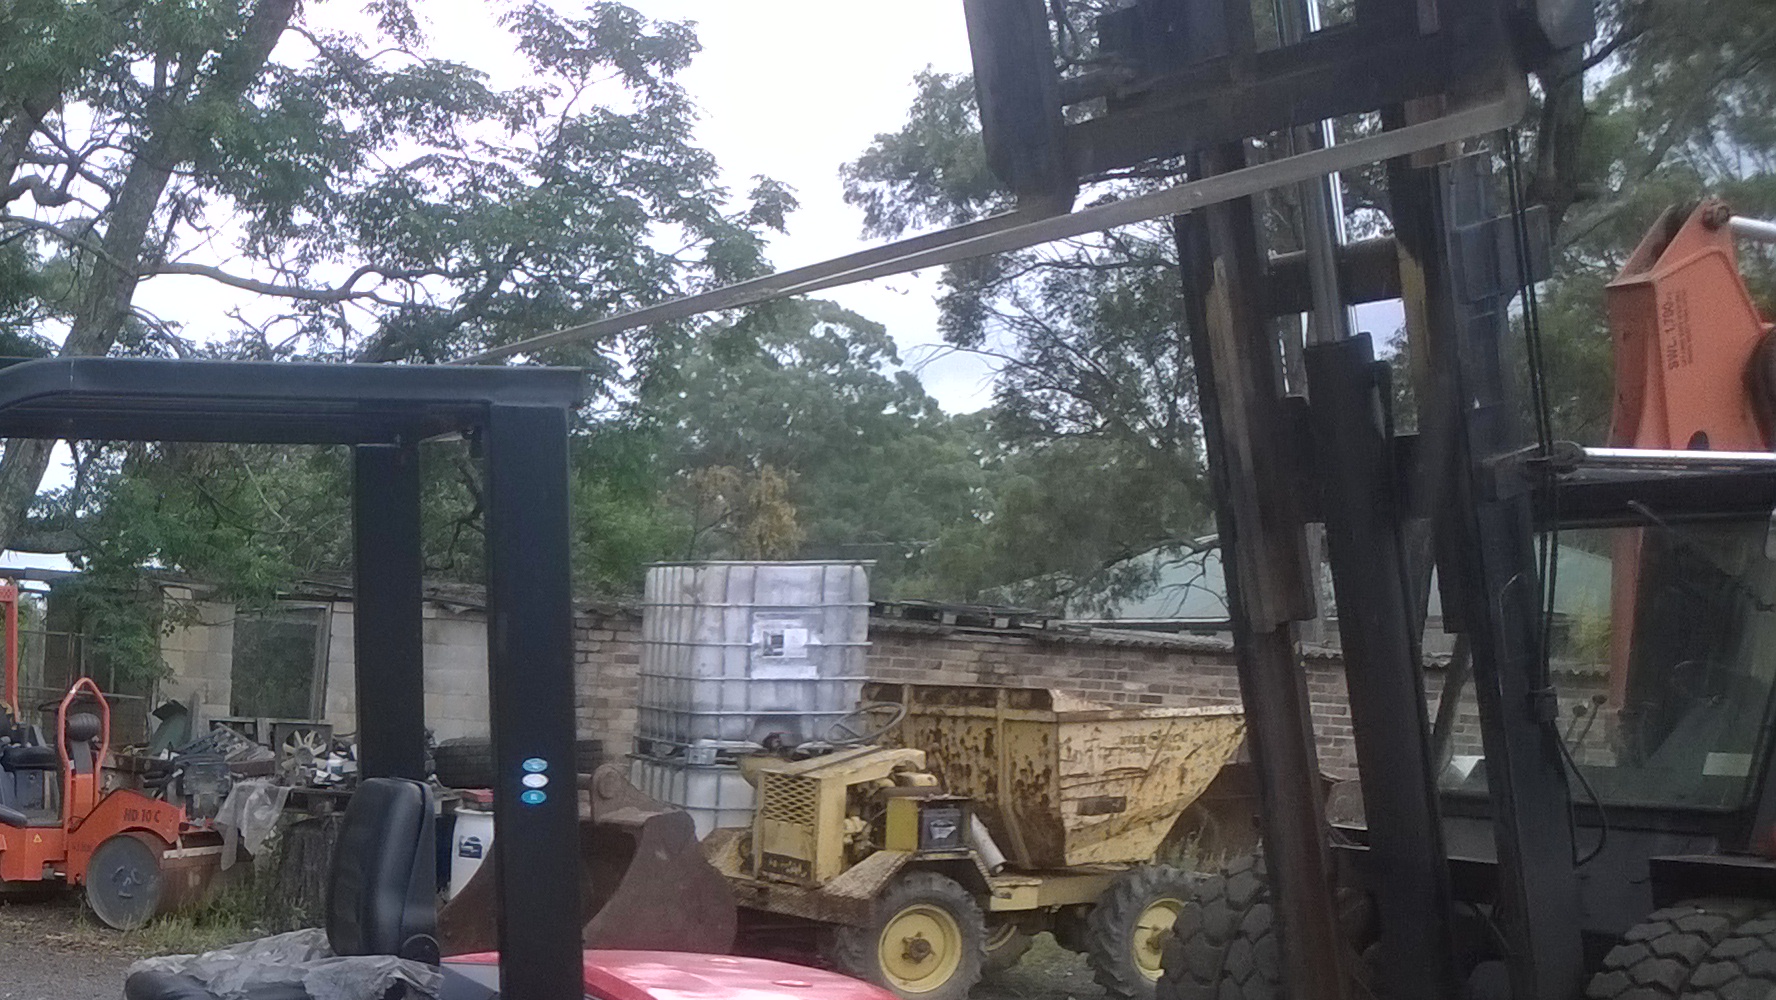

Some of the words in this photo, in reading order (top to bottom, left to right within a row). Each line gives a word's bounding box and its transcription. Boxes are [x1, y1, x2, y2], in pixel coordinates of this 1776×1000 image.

[124, 808, 138, 821] HD
[141, 809, 152, 822] 10
[154, 810, 161, 823] C
